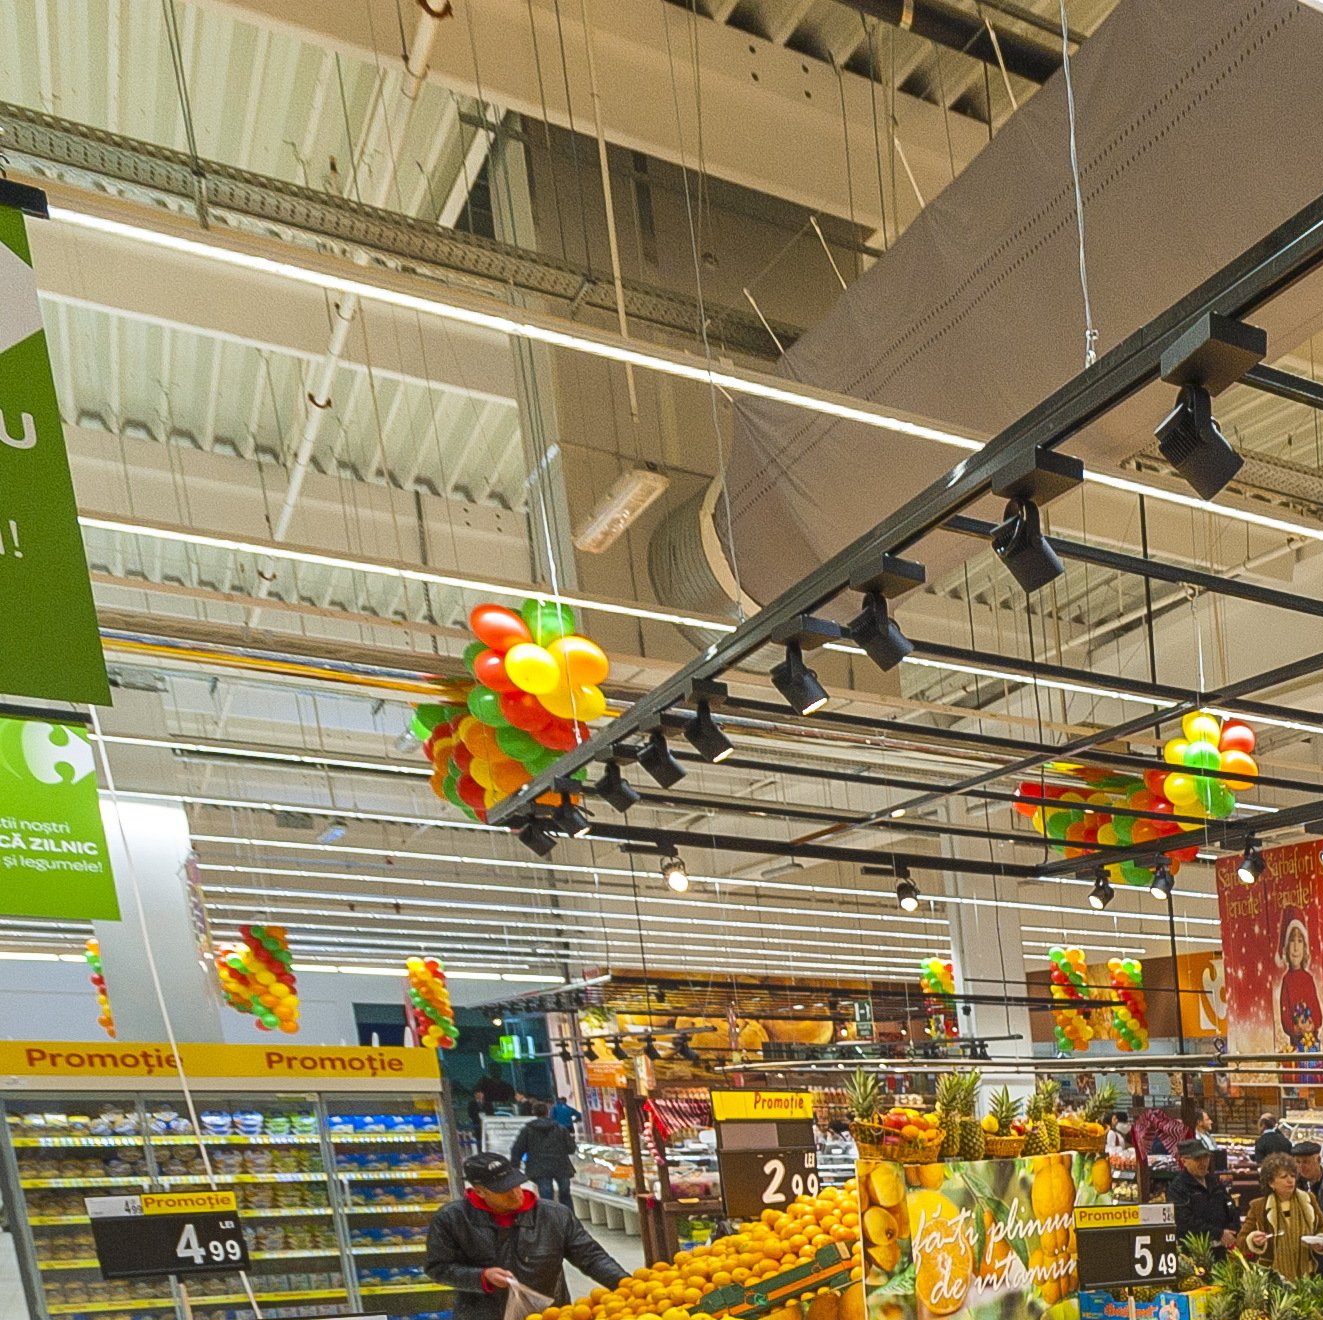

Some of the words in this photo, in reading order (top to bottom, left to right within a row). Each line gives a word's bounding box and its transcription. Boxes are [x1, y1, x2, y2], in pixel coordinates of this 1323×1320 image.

[29, 836, 98, 855] ZILNIC
[20, 855, 103, 873] legumele!
[25, 1048, 184, 1074] Promoție
[265, 1051, 404, 1077] Promoție
[754, 1091, 804, 1115] Promoție
[762, 1159, 786, 1203] 2
[792, 1173, 818, 1198] 99
[143, 1194, 232, 1209] Promoție
[1079, 1208, 1139, 1222] Promoție
[176, 1223, 206, 1264] 4
[208, 1239, 242, 1262] 99
[1134, 1235, 1153, 1276] 5
[1158, 1253, 1176, 1275] 49
[930, 1266, 968, 1304] de
